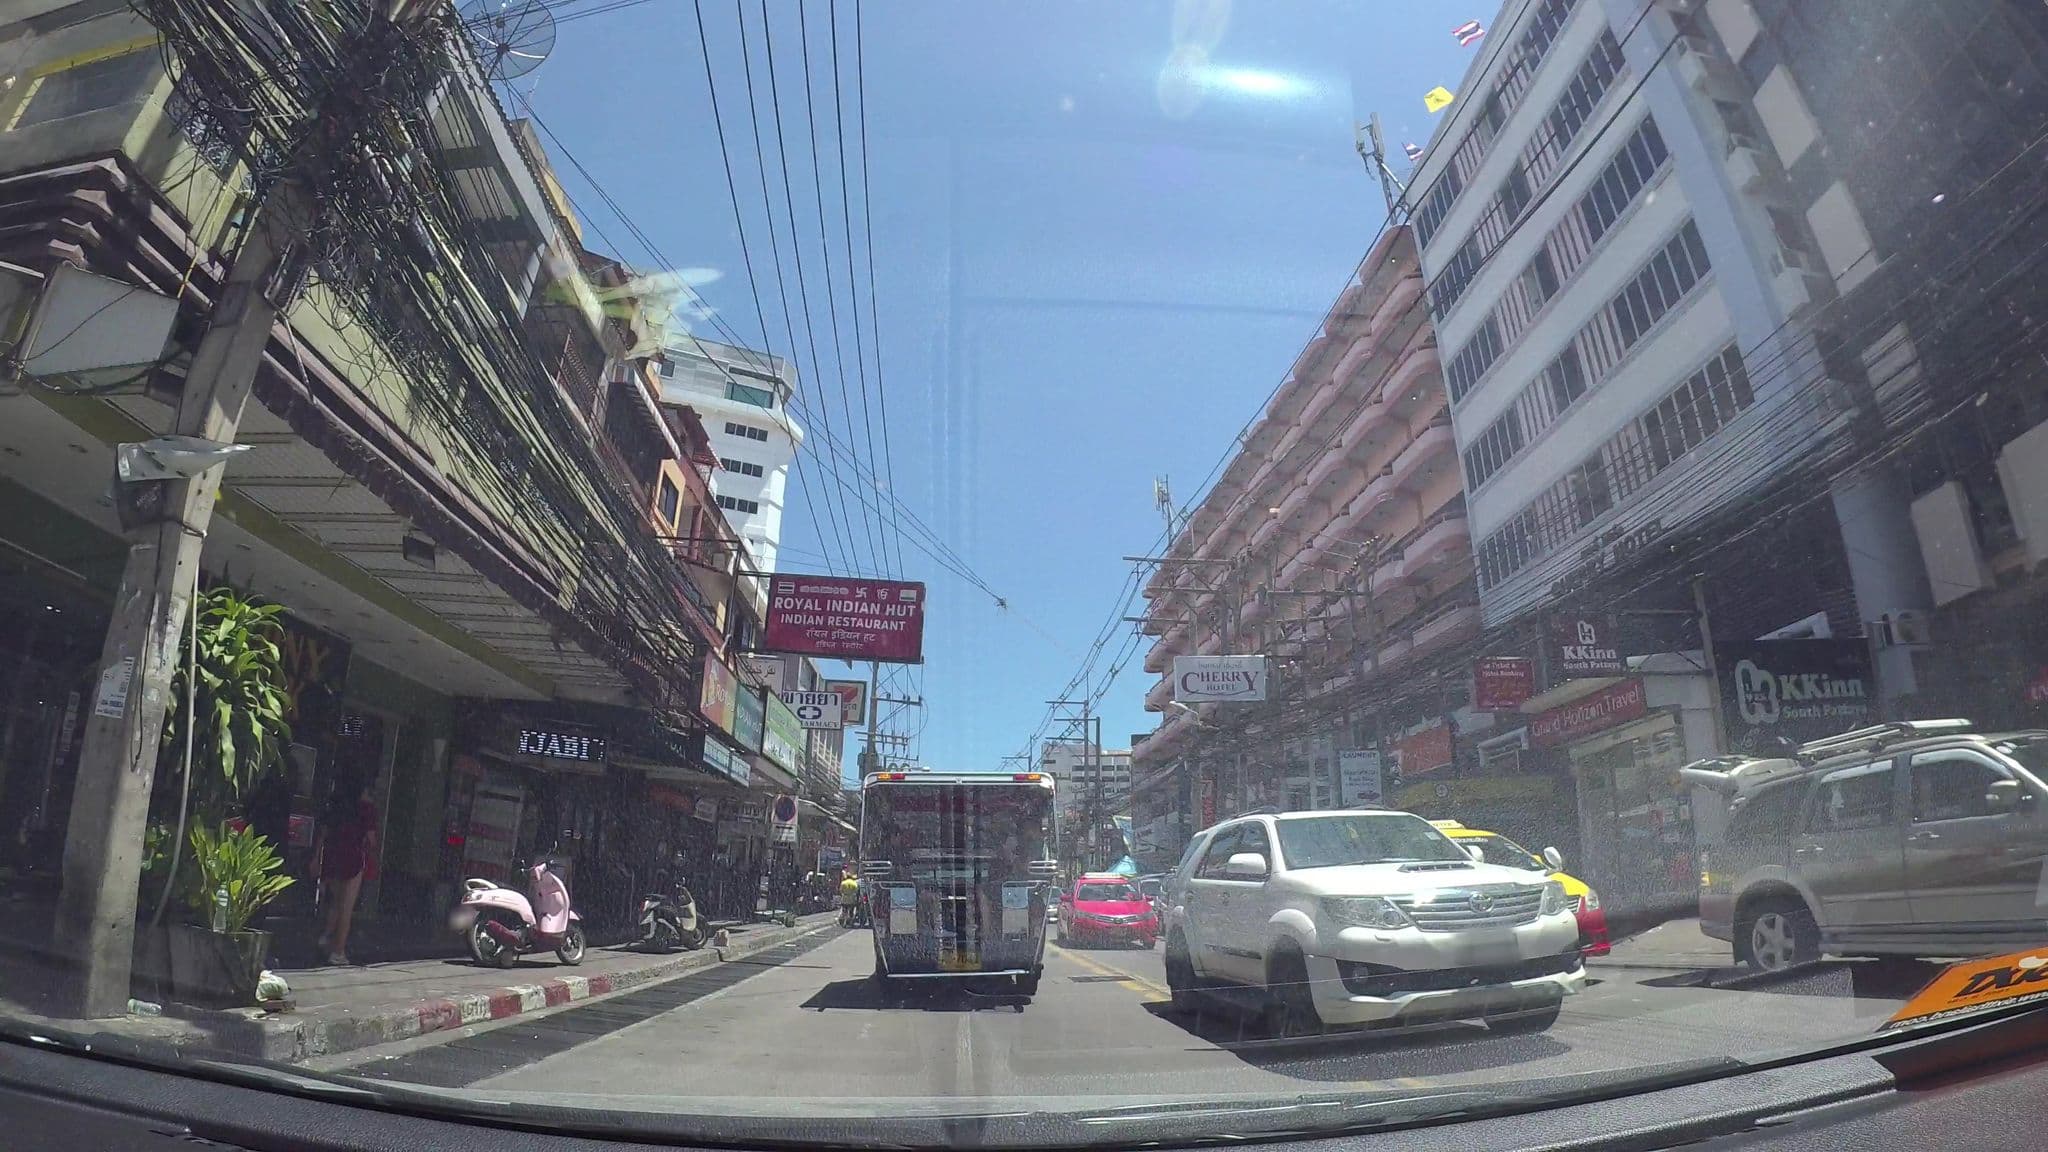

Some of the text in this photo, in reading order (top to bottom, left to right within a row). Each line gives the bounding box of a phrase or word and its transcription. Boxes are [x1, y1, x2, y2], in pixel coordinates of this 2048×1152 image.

[774, 597, 916, 617] ROYAL INDIAN HUT
[780, 613, 906, 631] INDIAN RESTAURANT
[1562, 645, 1617, 660] KKinn
[1563, 661, 1589, 671] South
[1181, 671, 1259, 694] CHERRY
[1206, 683, 1236, 691] HOTEL
[1778, 673, 1865, 700] KKinn
[1562, 701, 1604, 727] Horizon
[1603, 688, 1640, 712] Travel
[1782, 705, 1821, 721] South
[801, 720, 840, 728] ARMACY
